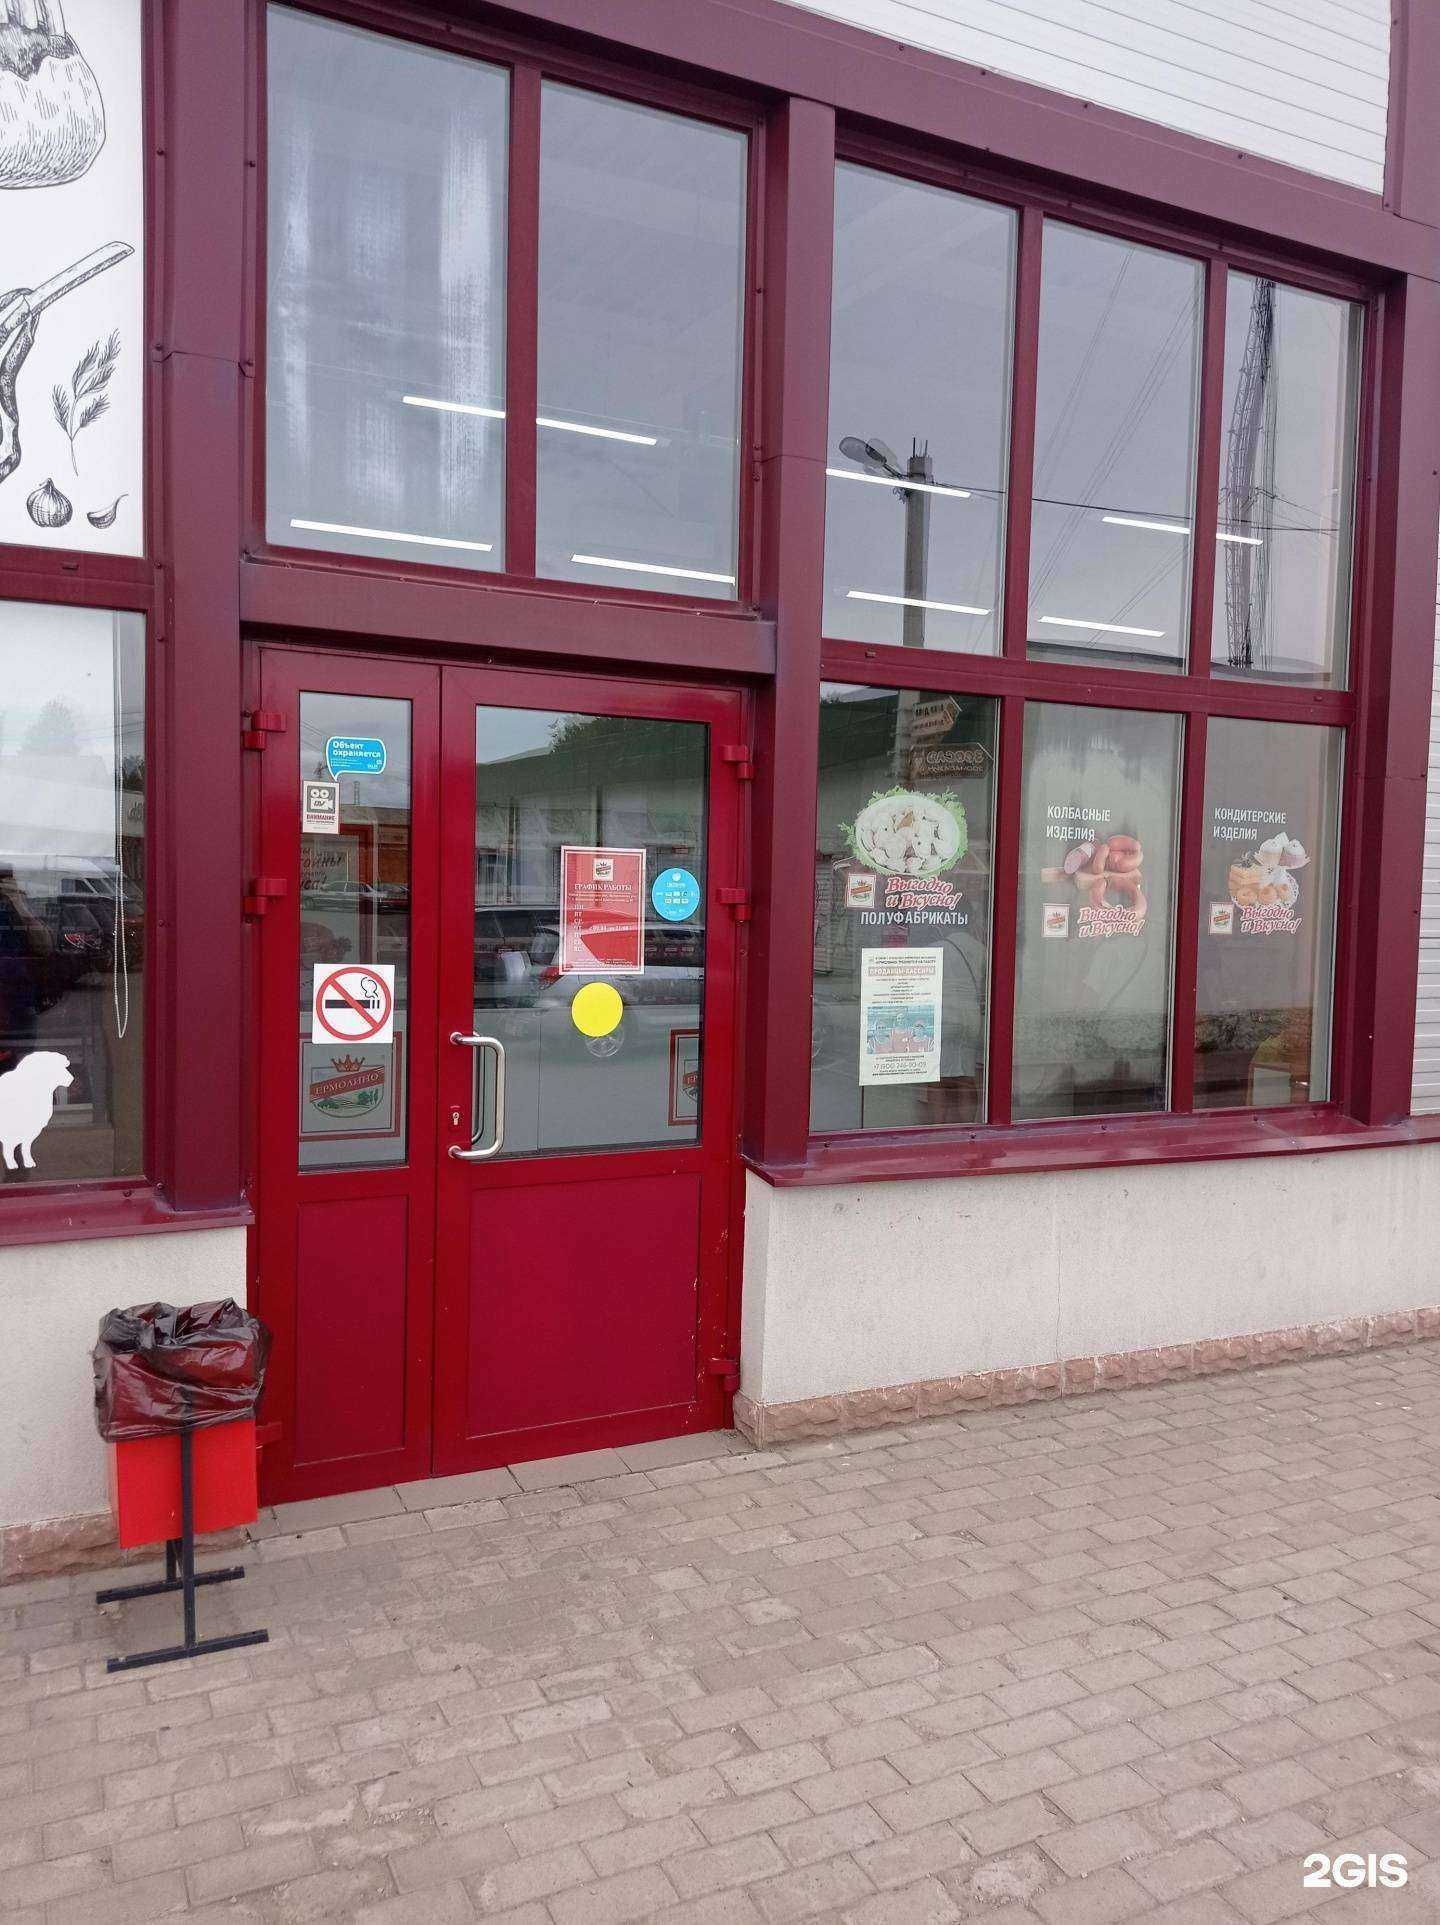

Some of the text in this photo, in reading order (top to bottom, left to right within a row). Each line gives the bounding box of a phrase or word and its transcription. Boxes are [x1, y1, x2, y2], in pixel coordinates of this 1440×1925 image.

[332, 741, 364, 750] Объект
[332, 750, 381, 758] охраняется
[1047, 805, 1111, 822] КОЛБАСНЫЕ
[1214, 807, 1287, 824] КОНДИТЕРСКИЕ
[1046, 825, 1095, 842] ИЗДЕЛИЯ
[1213, 826, 1258, 841] ИЗДЕЛИЯ
[574, 883, 603, 891] ГРАФИК
[885, 876, 954, 894] Выгодно
[885, 891, 963, 911] и Вкусно!
[860, 911, 968, 925] ПОЛУФАБРИКАТЫ
[1077, 905, 1137, 924] Выгодно
[1240, 905, 1295, 922] Выгодно
[1078, 919, 1146, 938] и Вкусно!
[1241, 920, 1253, 934] и
[1251, 917, 1303, 936] Вкусно!
[314, 1072, 379, 1095] ЕРМОЛИНО
